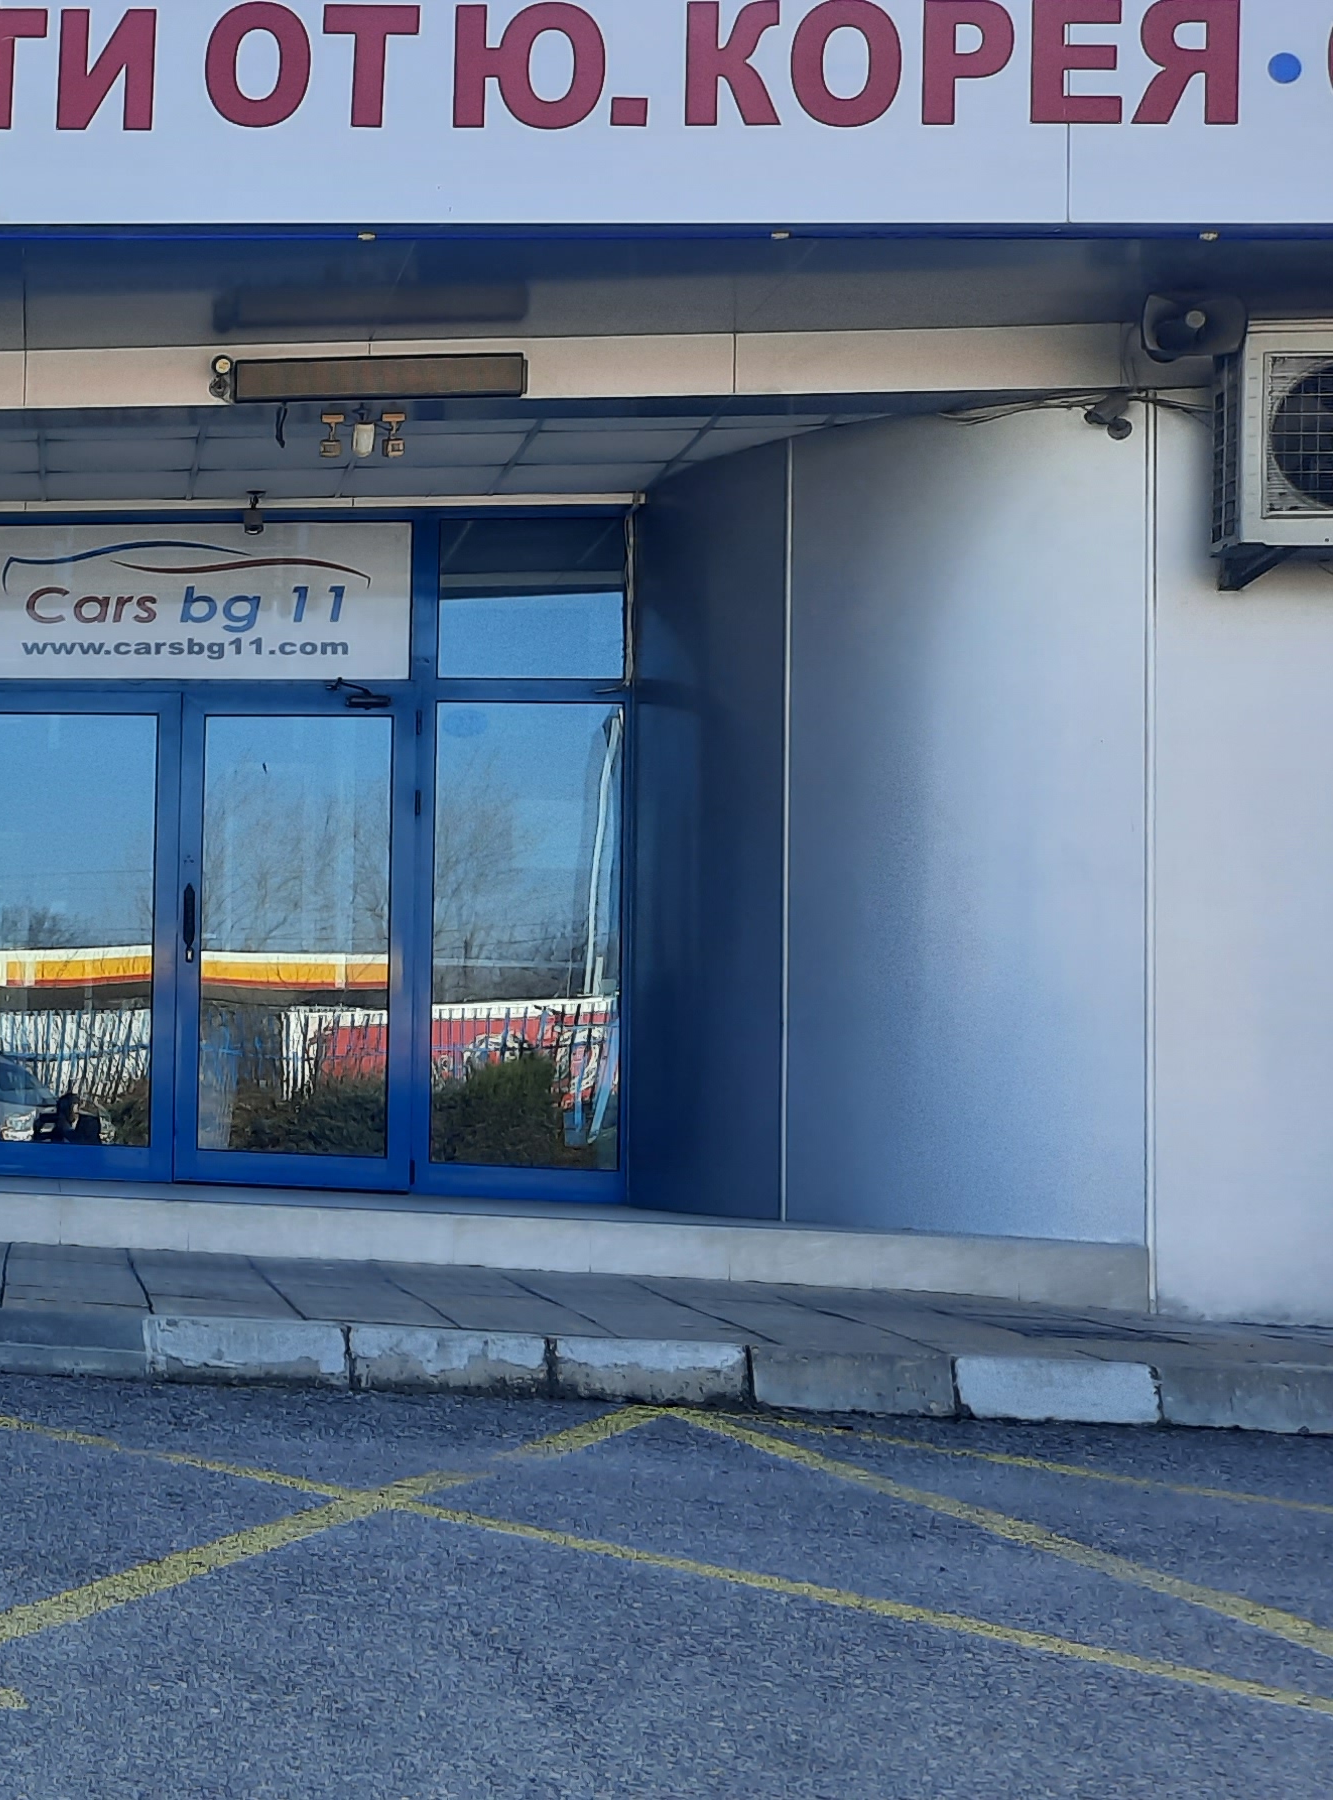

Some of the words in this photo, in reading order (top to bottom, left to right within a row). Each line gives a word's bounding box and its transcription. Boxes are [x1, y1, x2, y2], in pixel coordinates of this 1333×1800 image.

[204, 1, 421, 129] ОТ
[452, 1, 649, 130] Ю.
[684, 0, 1241, 127] КОРЕЯ
[25, 586, 159, 624] Cars
[179, 585, 262, 633] bg
[291, 585, 346, 623] 11
[21, 637, 349, 660] www.carsbg11.com
